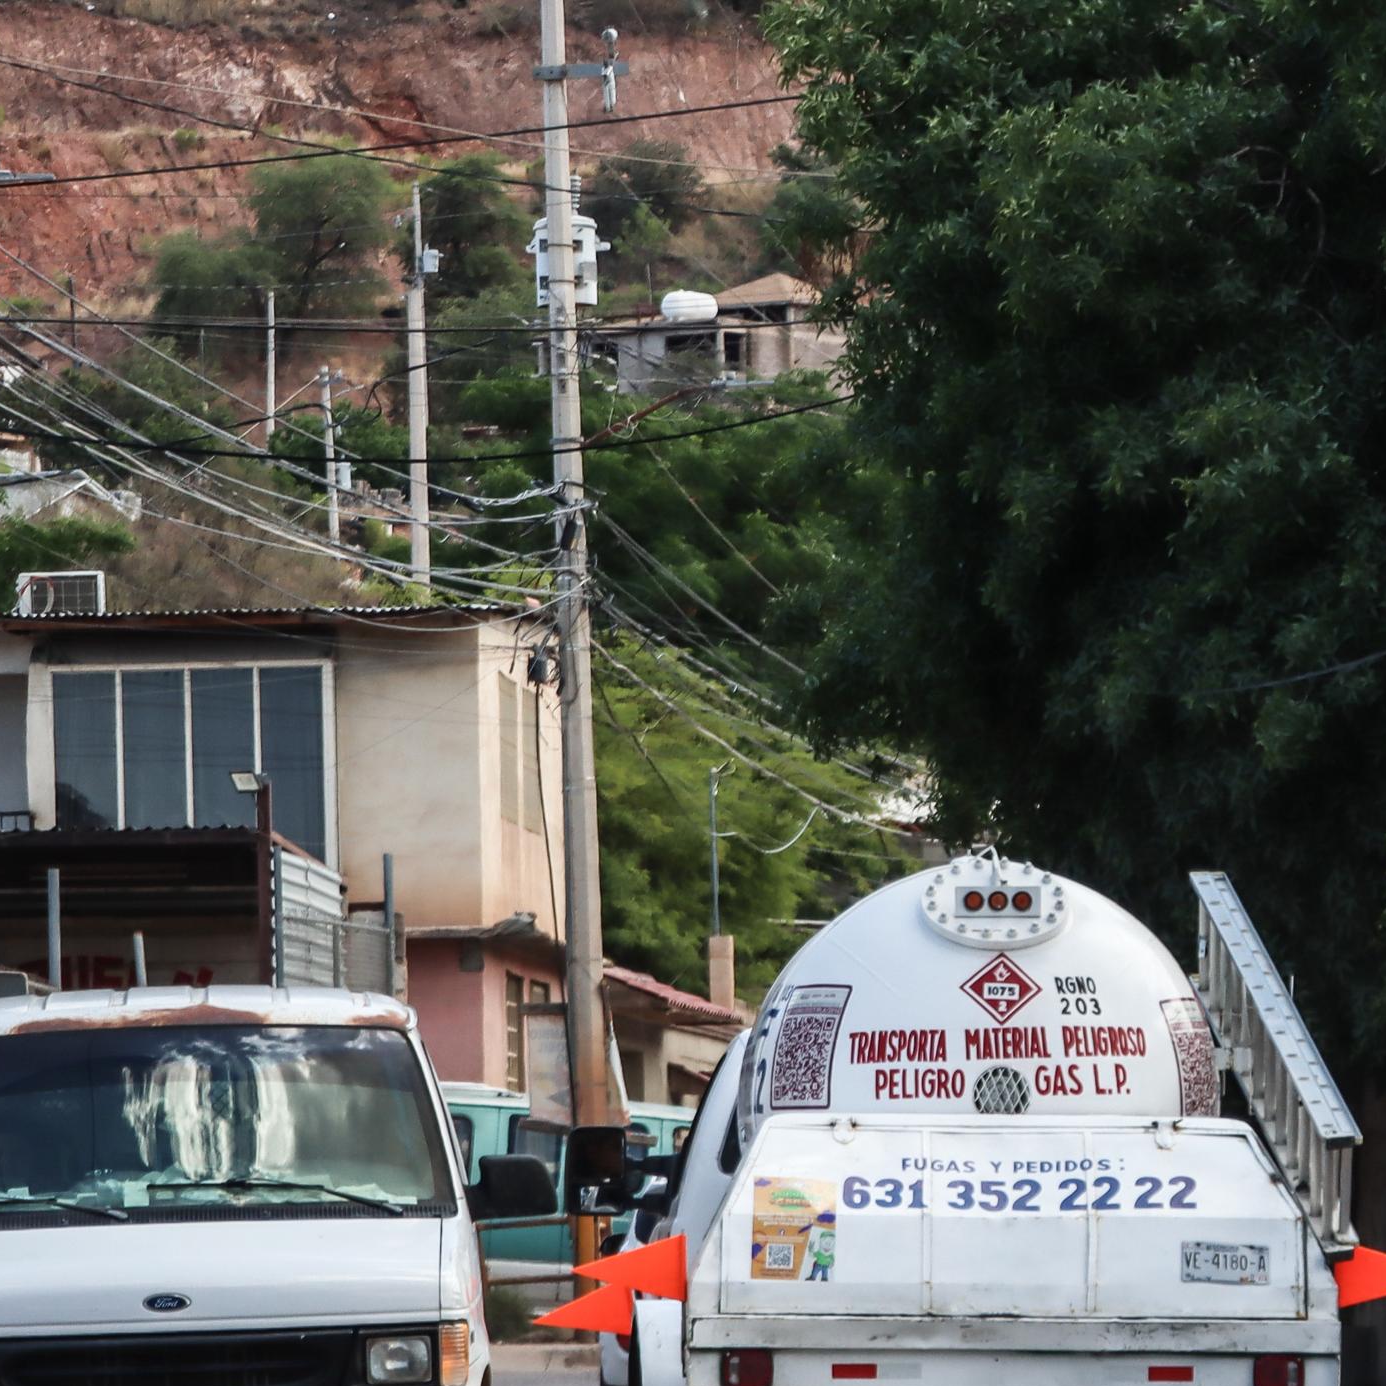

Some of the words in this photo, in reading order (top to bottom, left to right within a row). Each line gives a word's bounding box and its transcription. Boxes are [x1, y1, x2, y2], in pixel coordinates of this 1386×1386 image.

[987, 986, 1017, 997] 1075
[1054, 976, 1096, 995] RGNO
[998, 1001, 1008, 1013] 2
[1061, 997, 1102, 1016] 203
[849, 1029, 947, 1065] TRANSPORTA
[965, 1026, 1052, 1061] MATERIAL
[1061, 1025, 1147, 1058] PELIGROSO
[875, 1068, 965, 1100] PELIGRO
[1035, 1063, 1083, 1096] GAS
[1093, 1063, 1131, 1095] L.P.
[901, 1157, 975, 1173] FUGAS
[990, 1160, 1002, 1174] Y
[842, 1176, 928, 1209] 631
[946, 1178, 1043, 1212] 352
